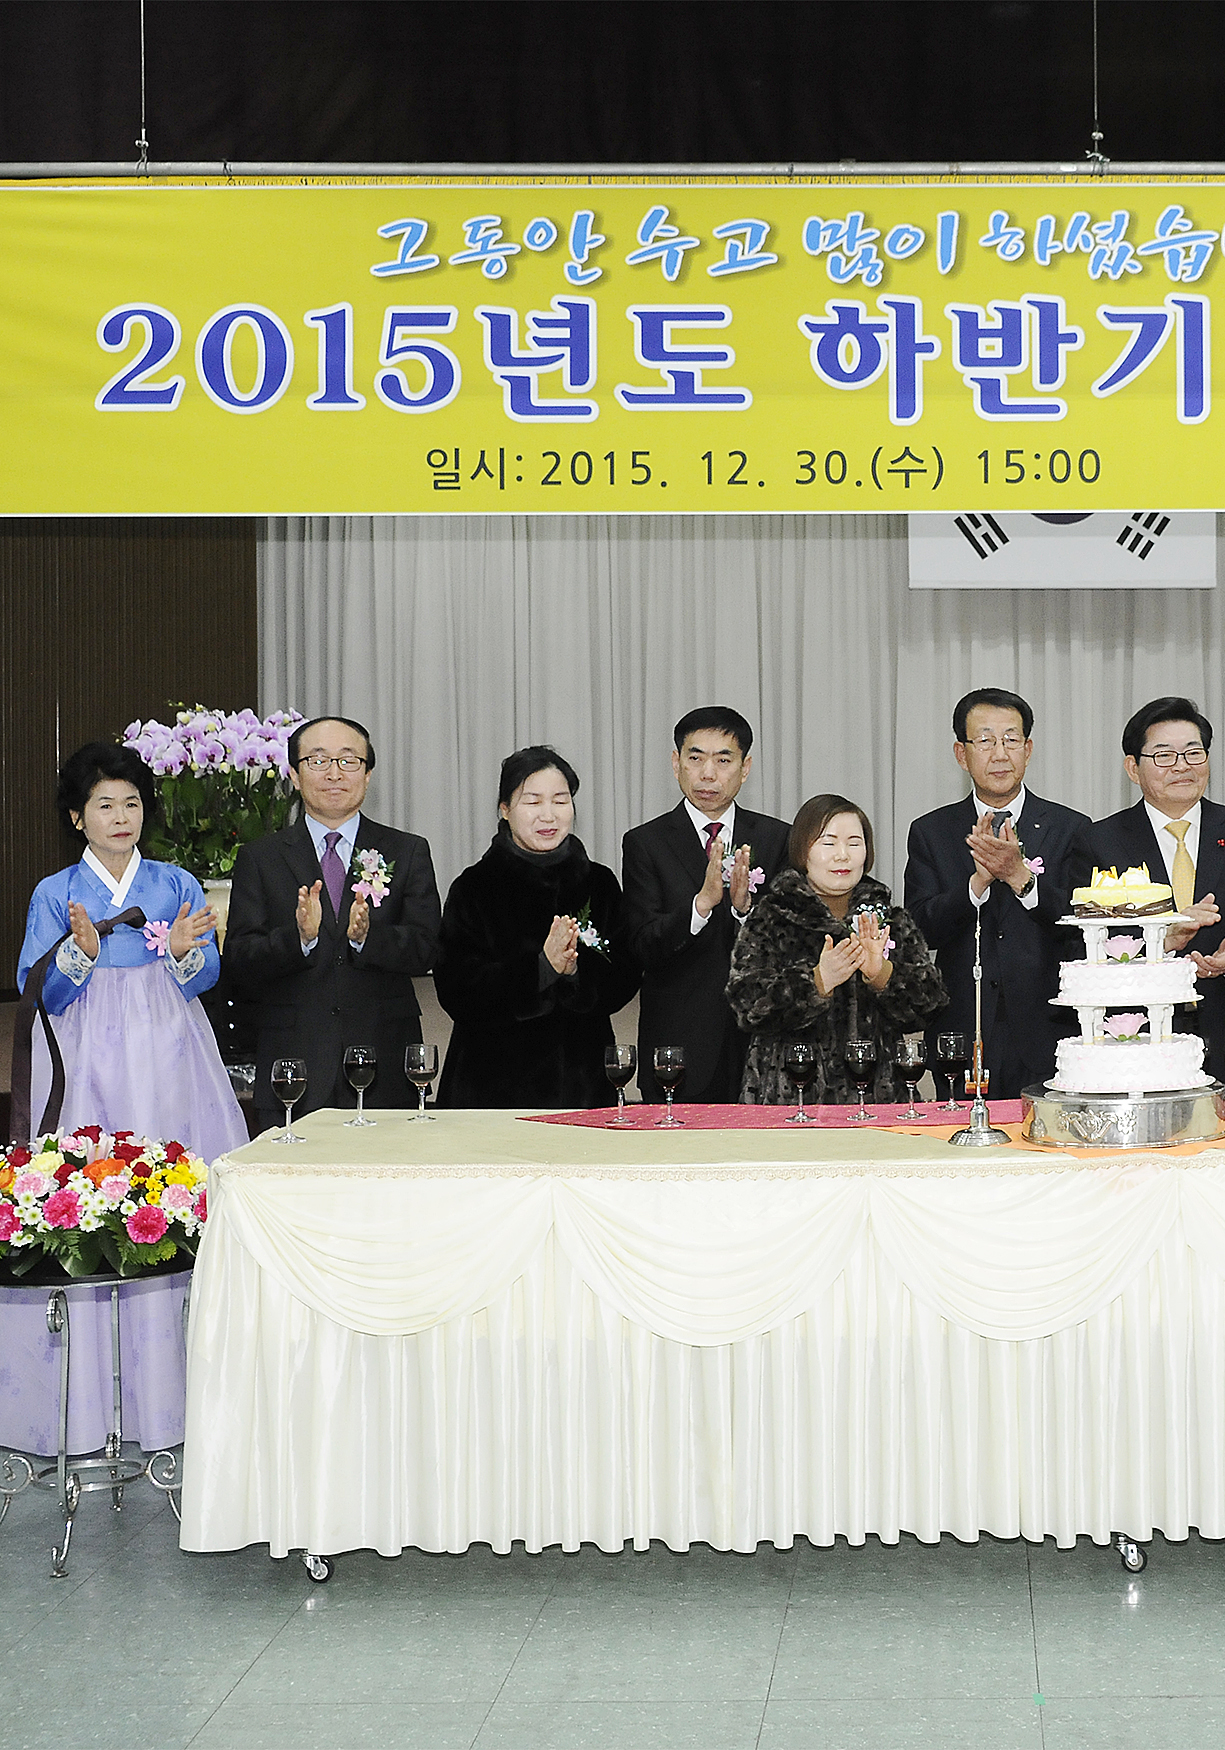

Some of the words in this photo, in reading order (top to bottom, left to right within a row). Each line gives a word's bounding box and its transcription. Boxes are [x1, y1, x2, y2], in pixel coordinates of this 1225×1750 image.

[370, 210, 604, 284] 그동안
[625, 205, 777, 280] 수고
[802, 210, 958, 286] 많이
[97, 296, 752, 420] 2015년도
[799, 294, 1210, 424] 하반기
[428, 448, 523, 490] 일시:
[541, 452, 668, 487] 2015.
[702, 451, 765, 487] 12.
[796, 448, 944, 491] 30.(수)
[978, 450, 1101, 485] 15:00
